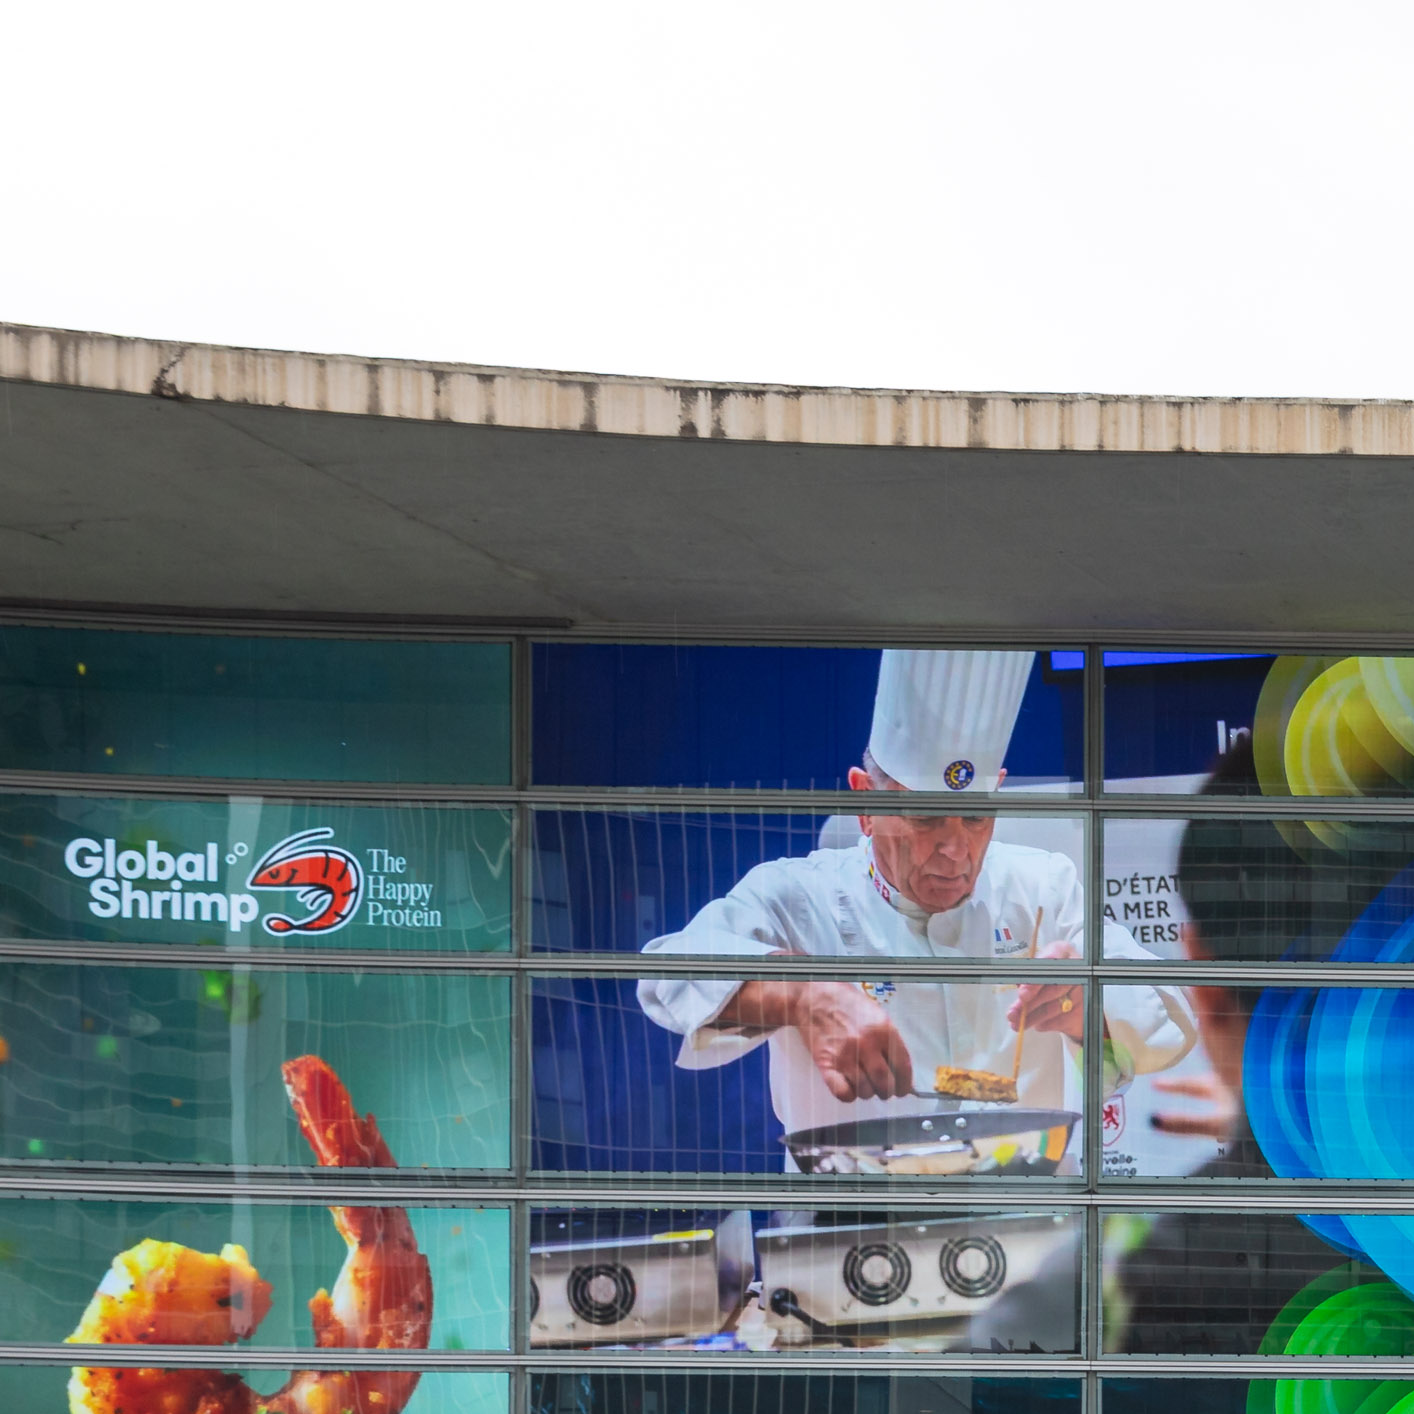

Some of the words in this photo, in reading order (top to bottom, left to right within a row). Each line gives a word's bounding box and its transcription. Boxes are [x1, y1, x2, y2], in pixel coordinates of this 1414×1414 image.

[65, 837, 218, 882] Global
[367, 848, 407, 873] The
[367, 876, 433, 904] Happy
[88, 878, 259, 932] Shrimp
[367, 902, 442, 927] Protein
[1123, 901, 1171, 920] MER
